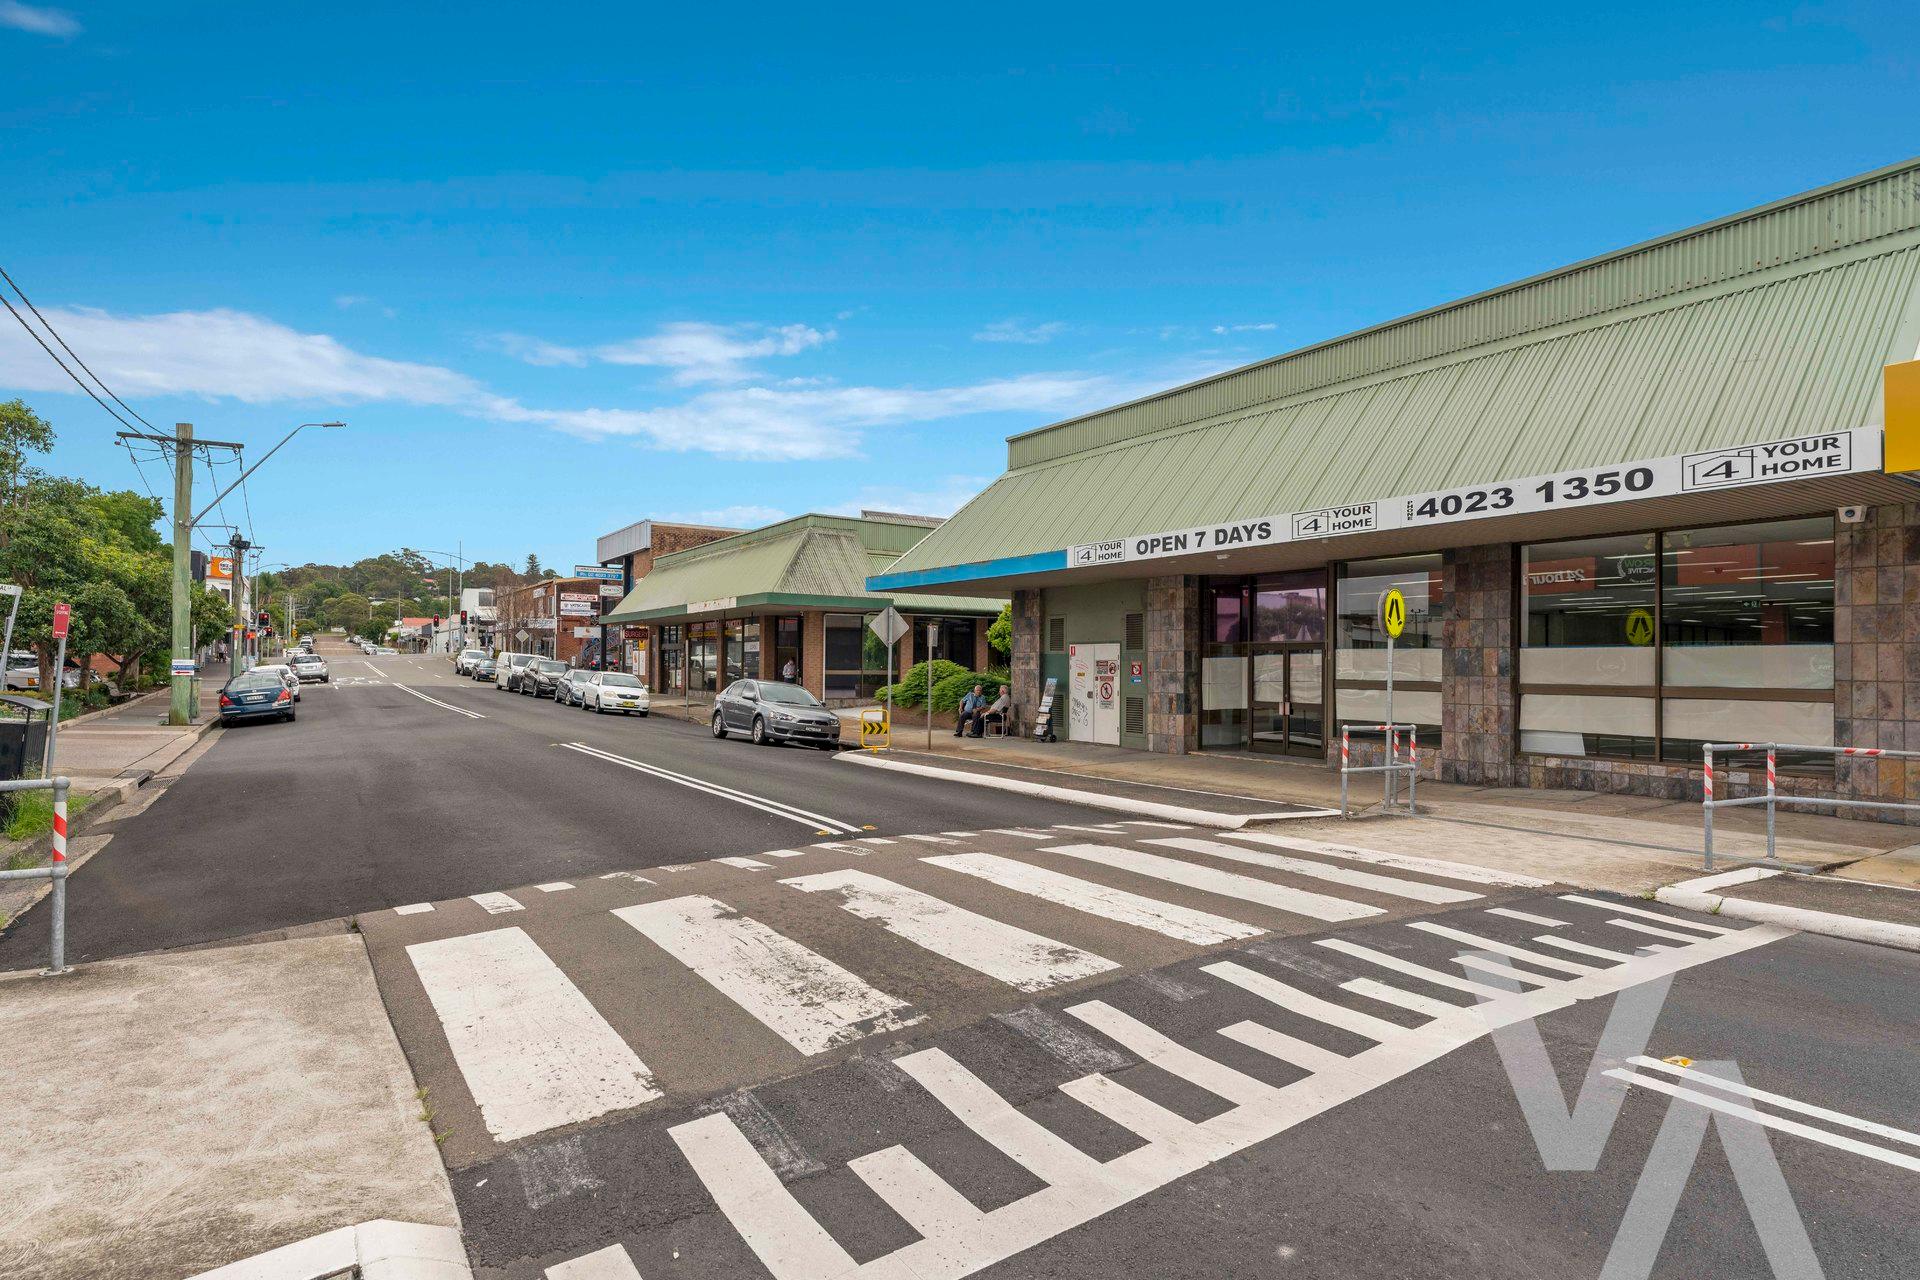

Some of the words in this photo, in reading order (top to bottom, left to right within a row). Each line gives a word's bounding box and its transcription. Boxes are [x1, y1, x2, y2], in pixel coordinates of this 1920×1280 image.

[1762, 437, 1841, 458] YOUR
[1702, 460, 1739, 479] 4
[1761, 454, 1842, 476] HOME
[1416, 487, 1514, 518] 4023
[1535, 467, 1654, 503] 1350
[1333, 505, 1371, 518] YOUR
[1302, 519, 1321, 532] 4
[1332, 518, 1372, 531] HOME
[1098, 542, 1122, 551] YOUR
[1136, 534, 1187, 555] OPEN
[1195, 532, 1207, 548] 7
[1215, 522, 1272, 546] DAYS
[1080, 549, 1092, 561] 4
[1098, 551, 1122, 561] HOME
